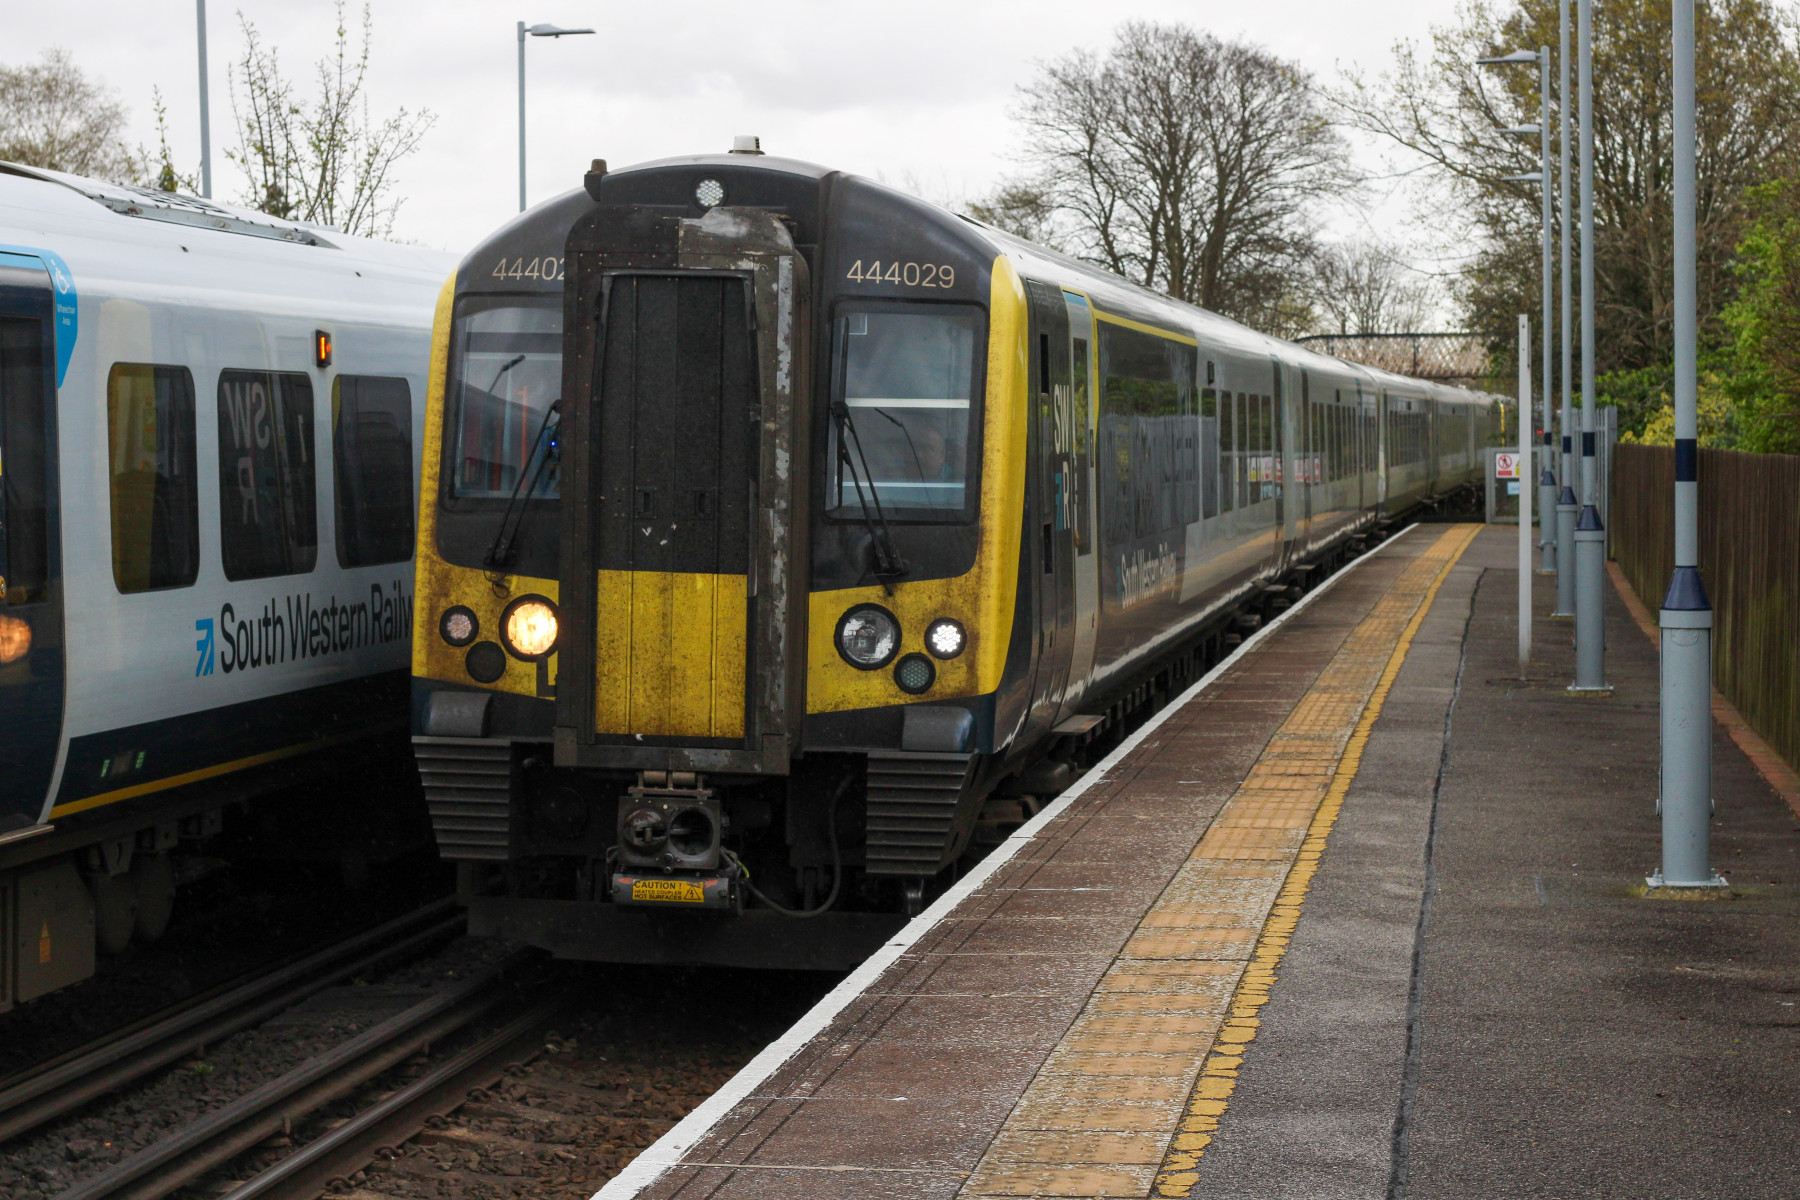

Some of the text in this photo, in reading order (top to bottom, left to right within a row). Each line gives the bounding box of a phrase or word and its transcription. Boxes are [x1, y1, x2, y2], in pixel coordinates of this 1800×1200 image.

[492, 257, 564, 280] 44402
[847, 260, 954, 288] 444029
[1054, 384, 1069, 454] SW
[1062, 461, 1070, 530] R
[221, 579, 413, 673] South Western Railw
[634, 881, 676, 889] CAUTION
